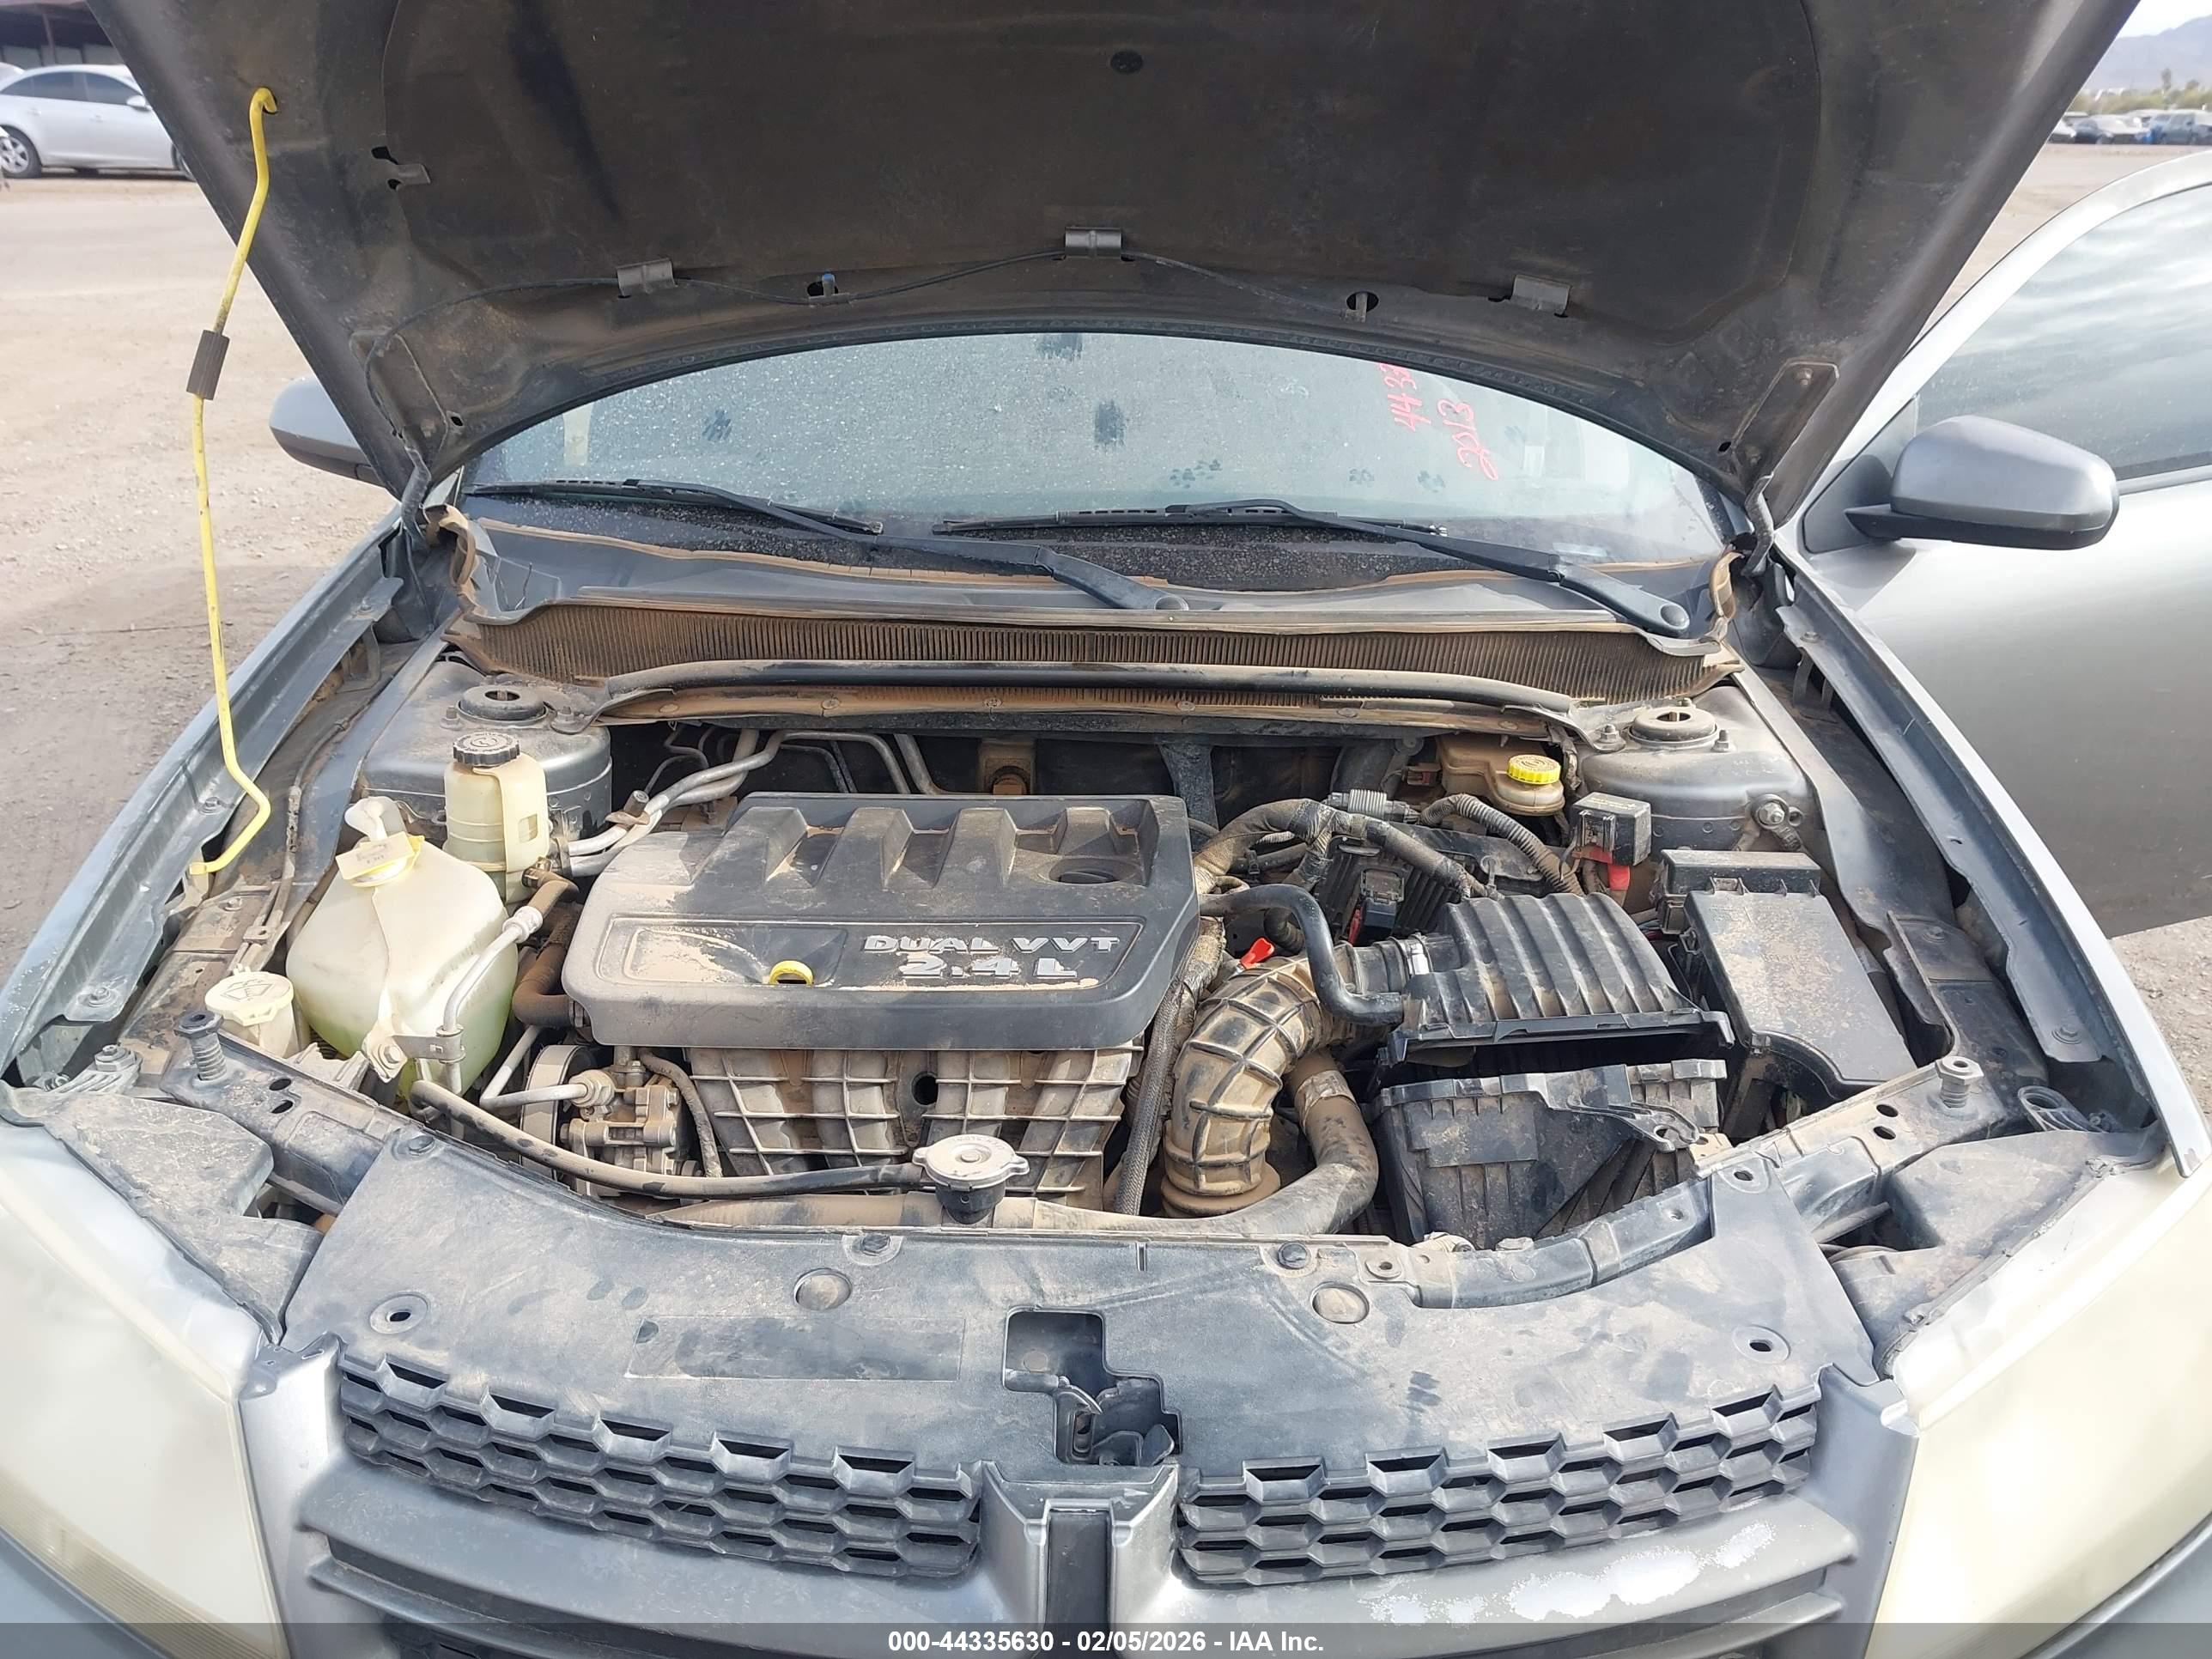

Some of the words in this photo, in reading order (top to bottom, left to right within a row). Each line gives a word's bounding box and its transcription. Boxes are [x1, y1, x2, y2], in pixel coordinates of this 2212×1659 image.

[1437, 398, 1499, 481] 2013
[864, 934, 1000, 954] DUAL
[1011, 936, 1119, 953] VVT
